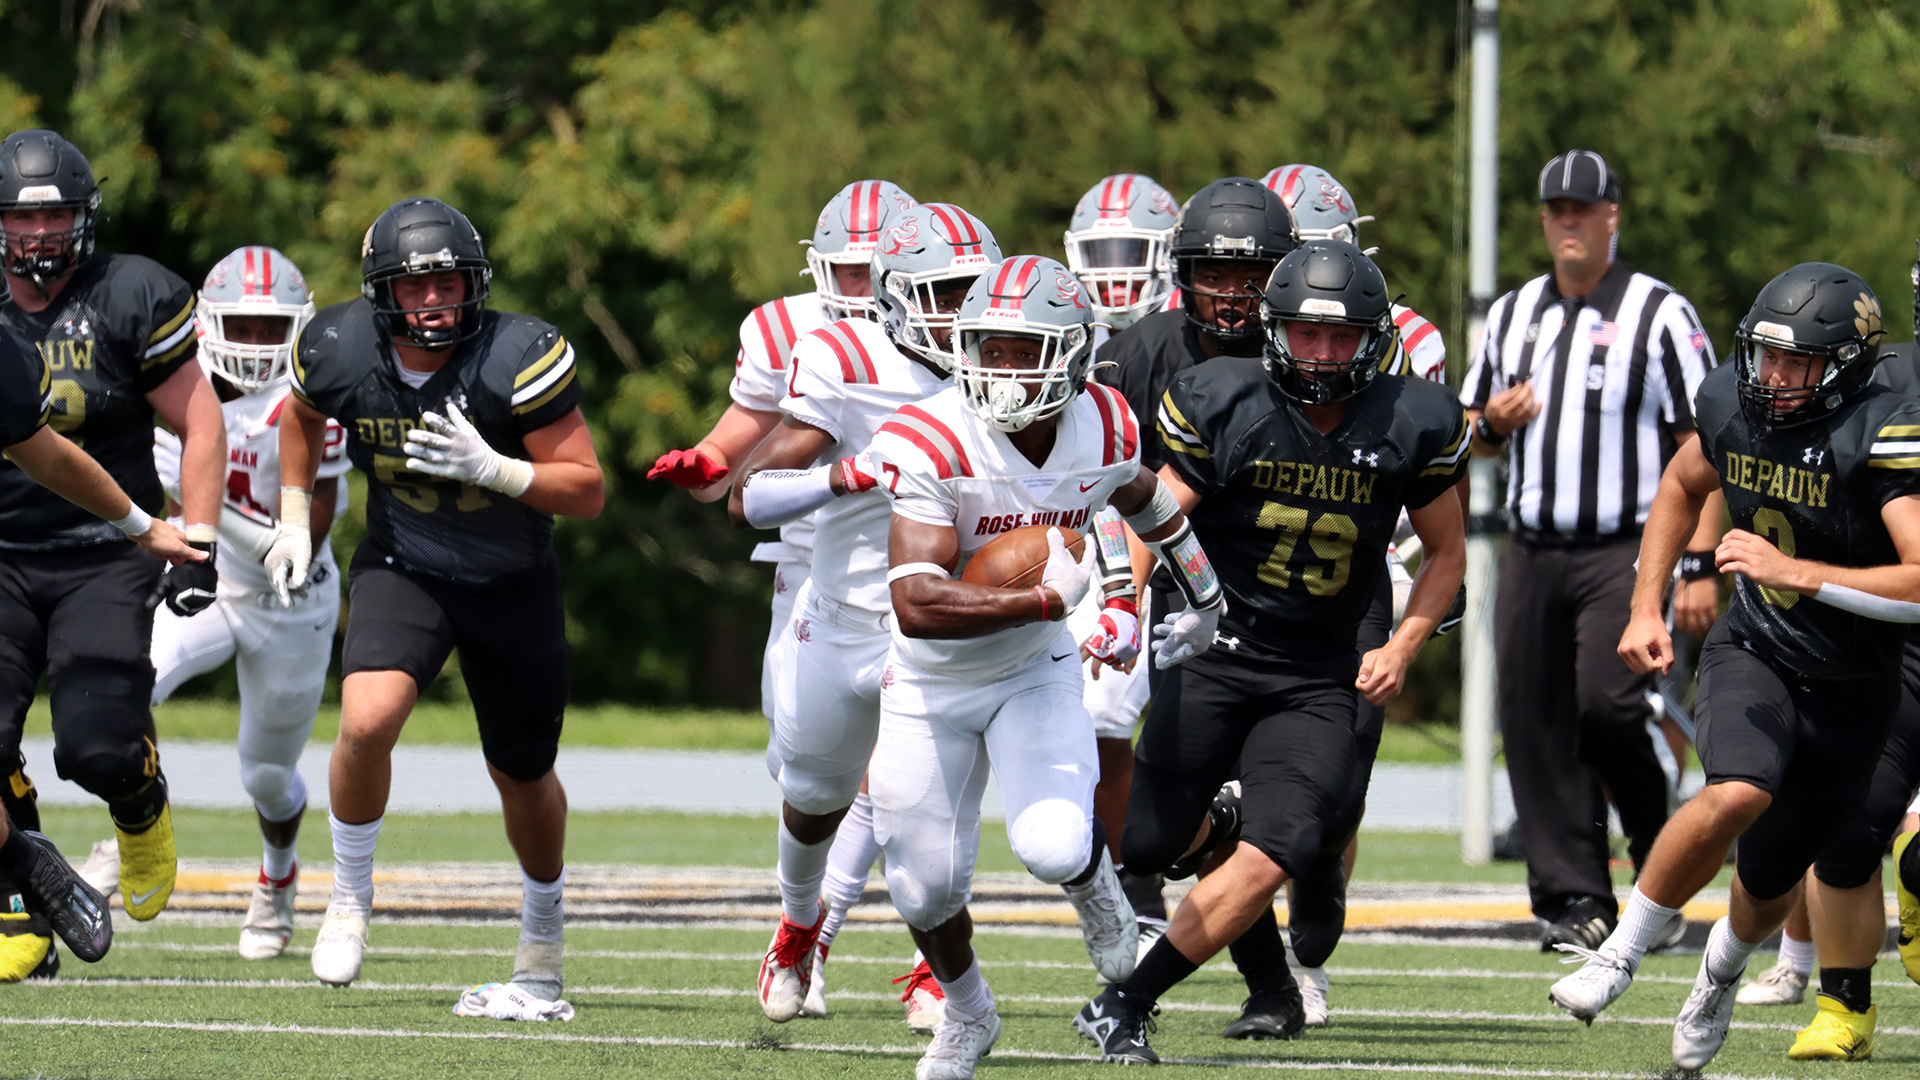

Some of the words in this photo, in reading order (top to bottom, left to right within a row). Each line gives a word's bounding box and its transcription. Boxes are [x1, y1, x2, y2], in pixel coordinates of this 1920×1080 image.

[999, 311, 1020, 319] WORK
[1760, 324, 1784, 337] CHIEF
[1587, 363, 1606, 390] S
[881, 460, 904, 500] 7
[1251, 459, 1379, 504] DEPAUW
[1725, 451, 1831, 508] DEPAUW
[974, 503, 1092, 535] ROSE-HULMAN
[1256, 500, 1359, 596] 79
